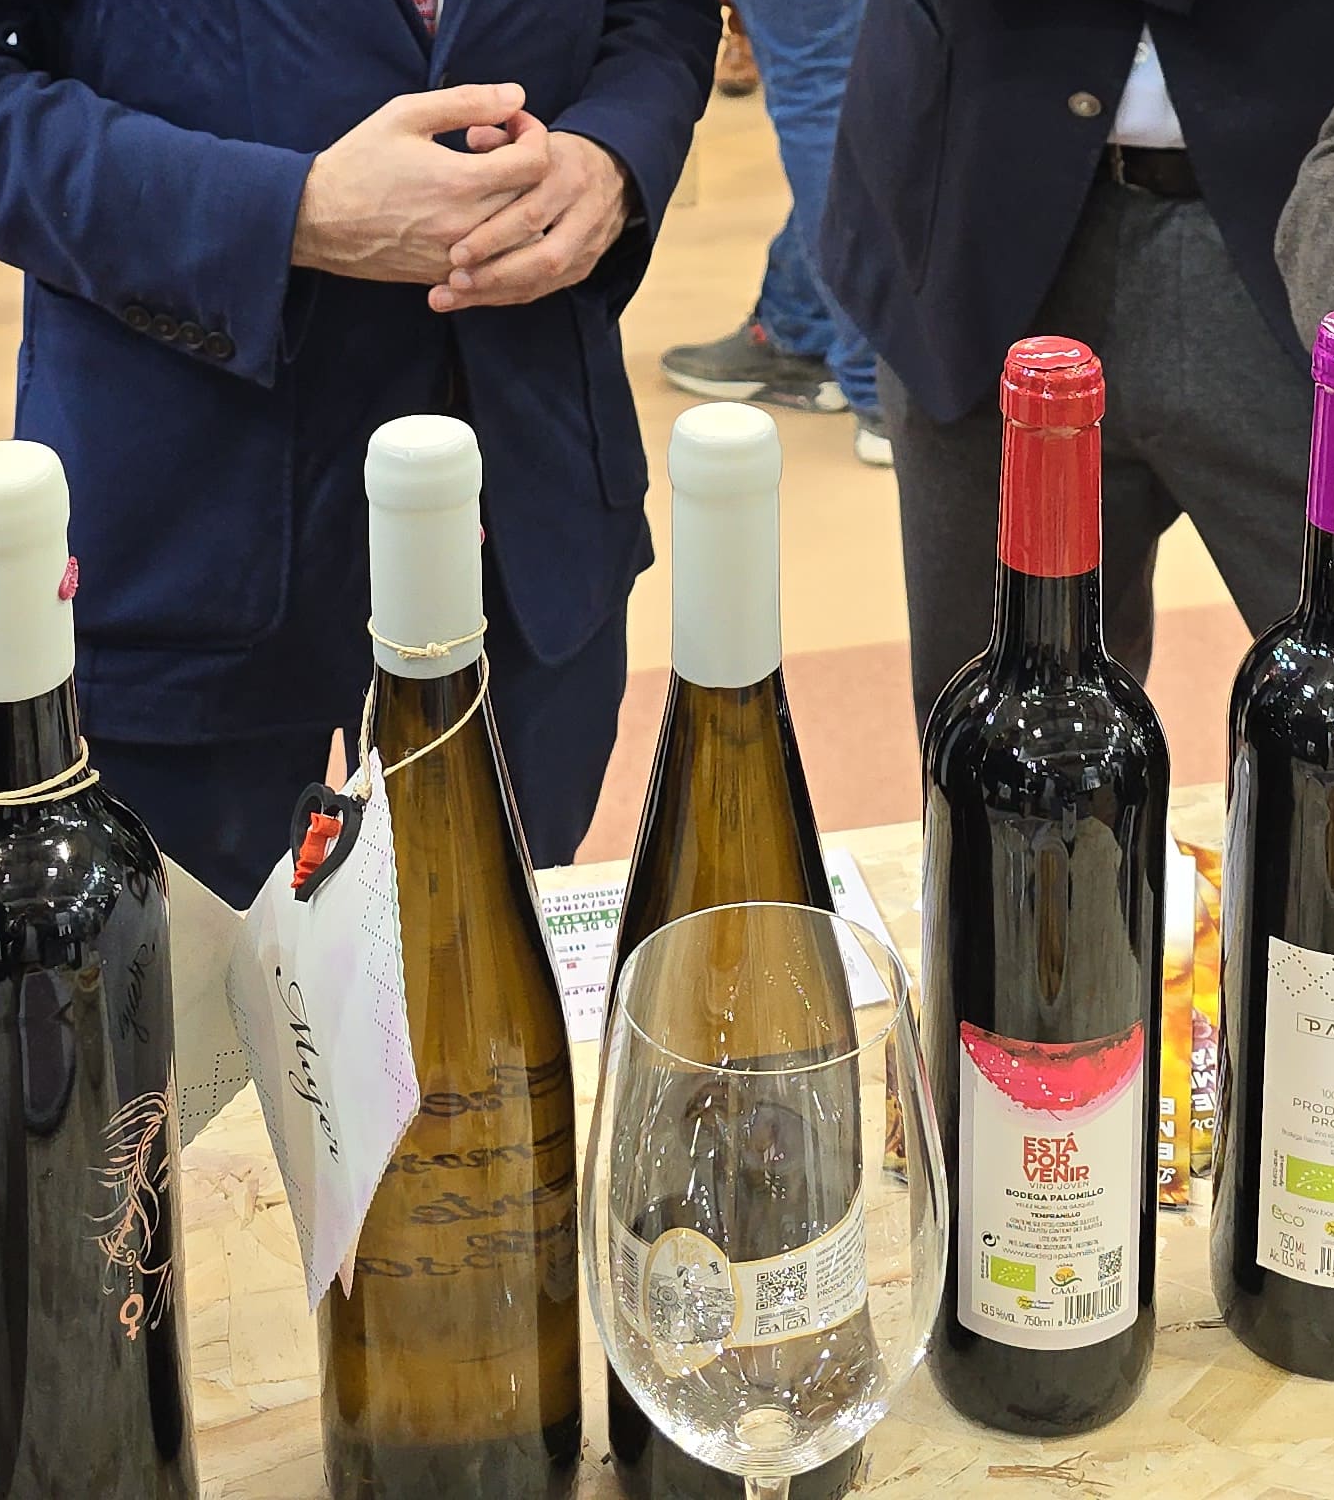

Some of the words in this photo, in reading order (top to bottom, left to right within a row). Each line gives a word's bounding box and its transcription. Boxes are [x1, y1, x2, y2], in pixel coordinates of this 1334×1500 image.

[275, 966, 340, 1164] Mujer
[1024, 1132, 1078, 1153] ESTÁ
[1024, 1152, 1070, 1168] POR
[1023, 1166, 1089, 1182] VENIR
[1029, 1182, 1053, 1190] VINO
[1057, 1180, 1089, 1190] JOVEN
[1006, 1189, 1047, 1201] BODEGA
[1050, 1188, 1104, 1201] PALOMILLO
